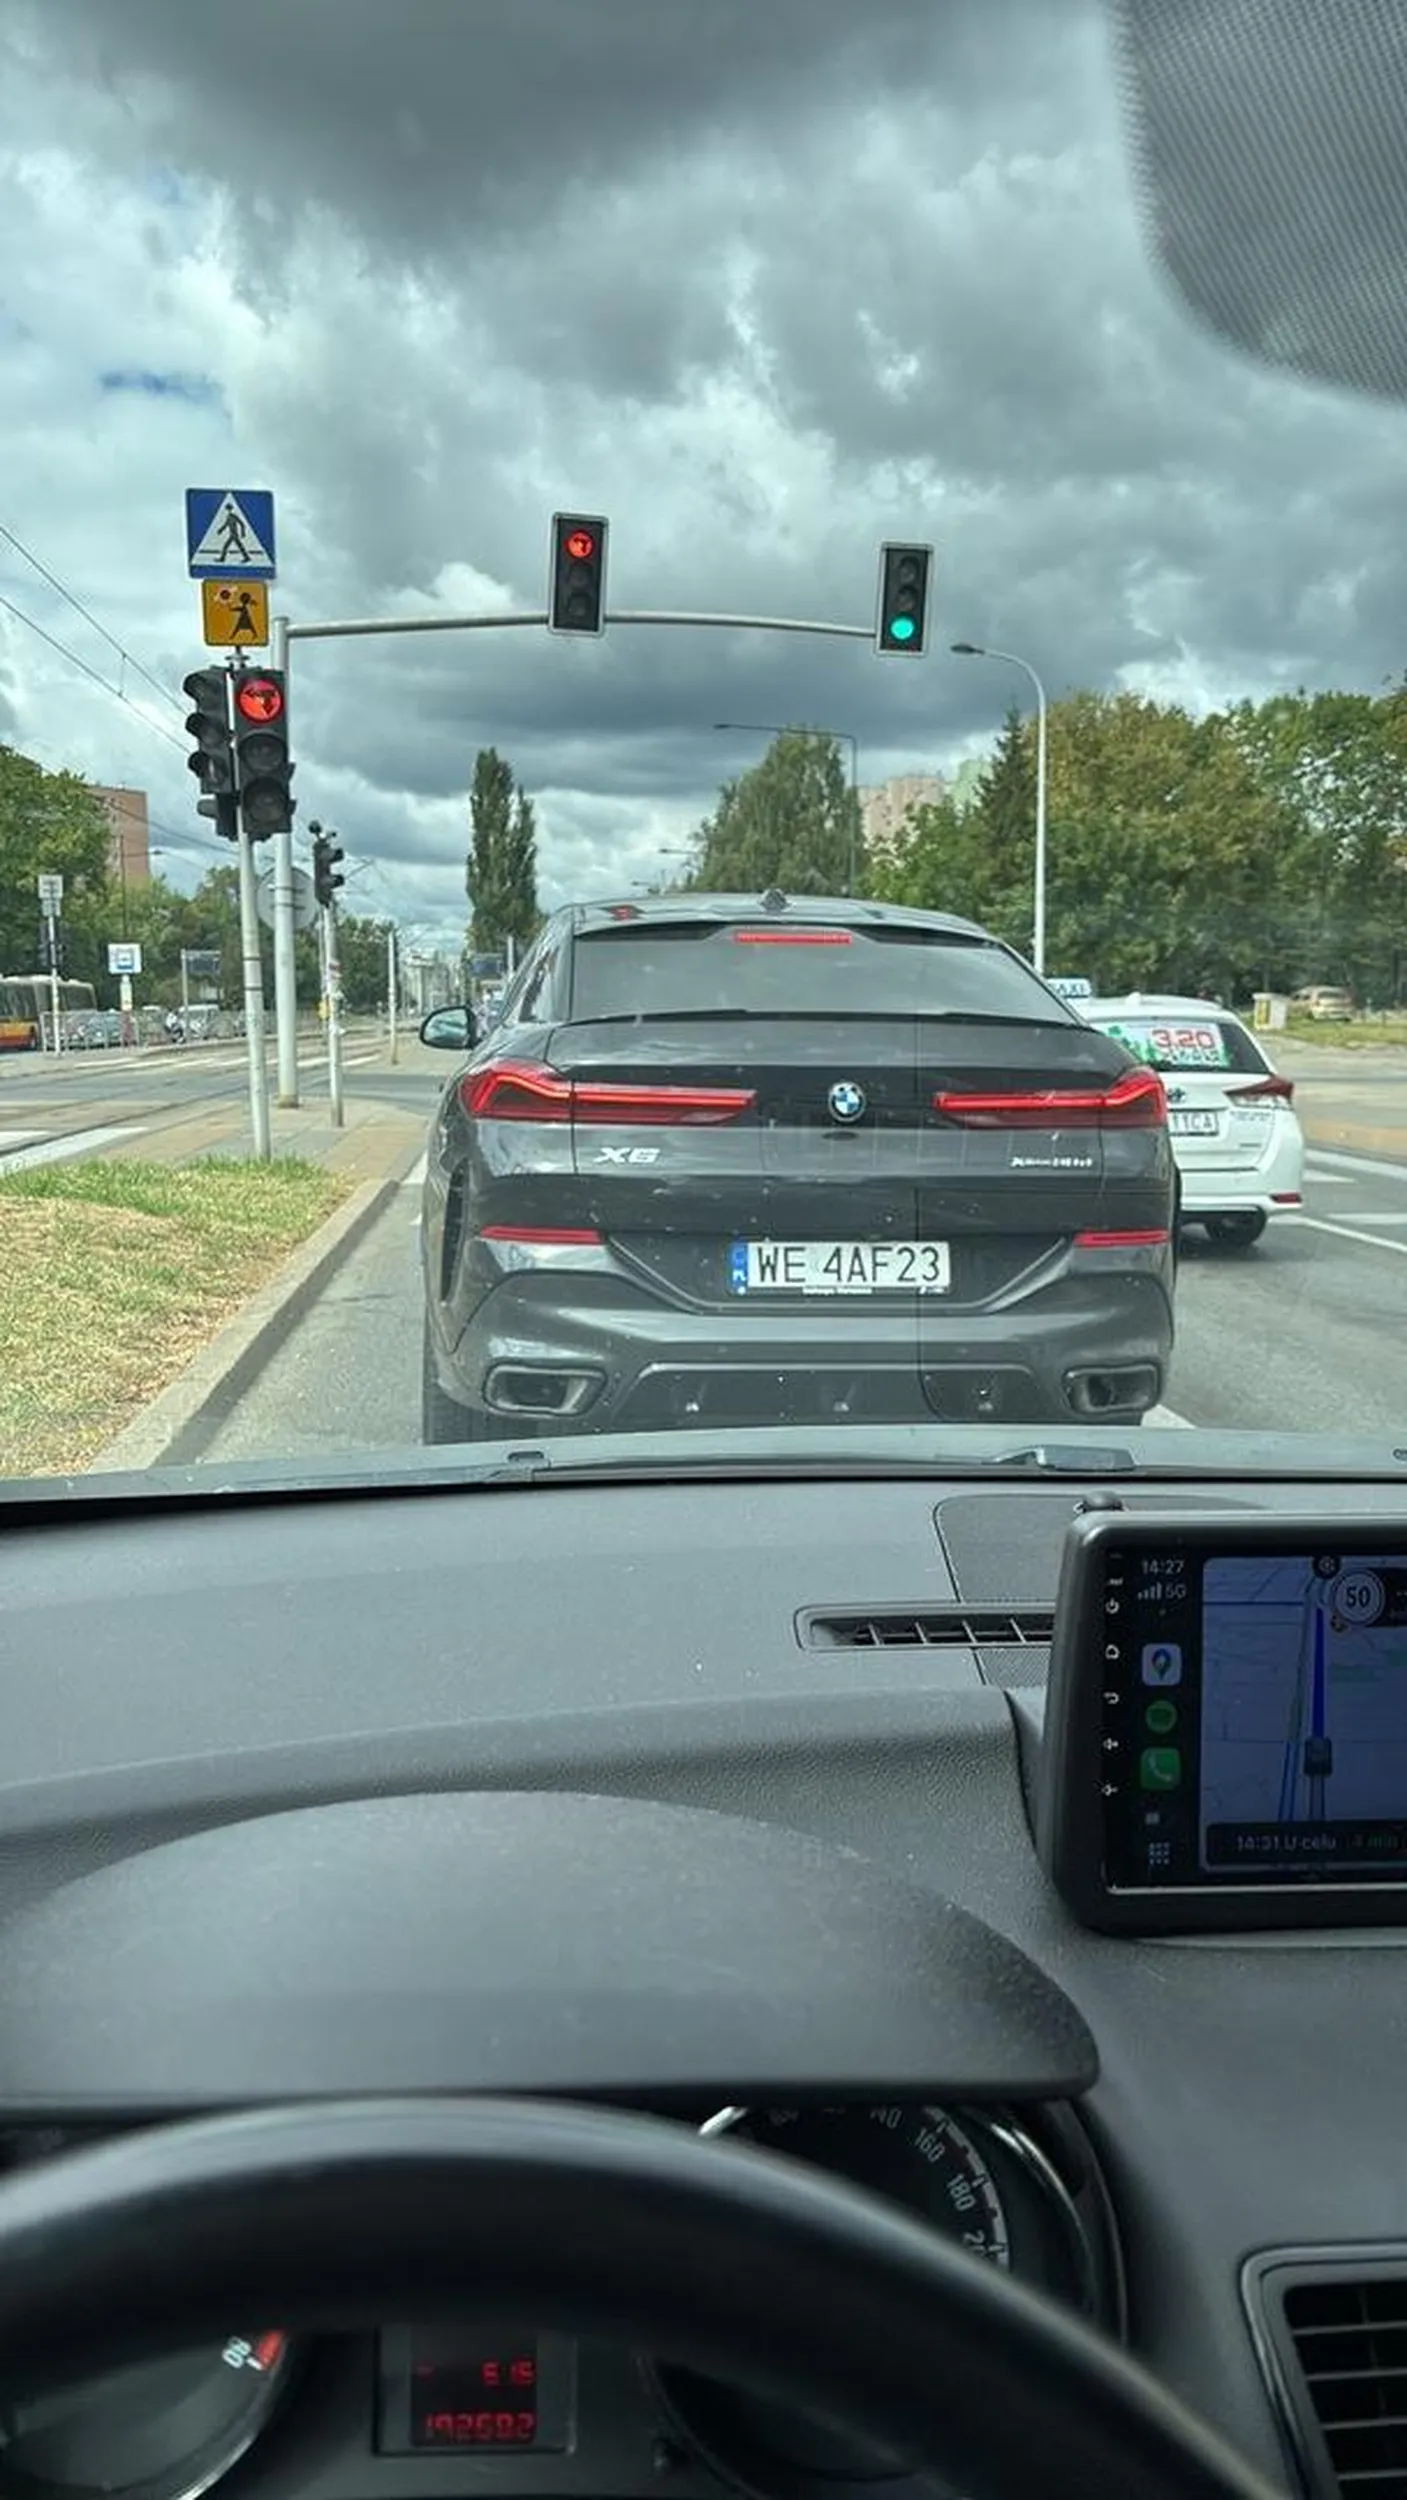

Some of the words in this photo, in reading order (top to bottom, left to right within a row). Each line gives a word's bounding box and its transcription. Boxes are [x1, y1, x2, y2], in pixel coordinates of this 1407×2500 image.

[593, 1147, 660, 1163] X6
[757, 1246, 806, 1283] WE
[823, 1246, 940, 1283] 4AF23
[1143, 1559, 1184, 1575] 14:27
[1346, 1586, 1371, 1608] 50
[914, 2128, 946, 2163] 160
[947, 2174, 976, 2211] 180
